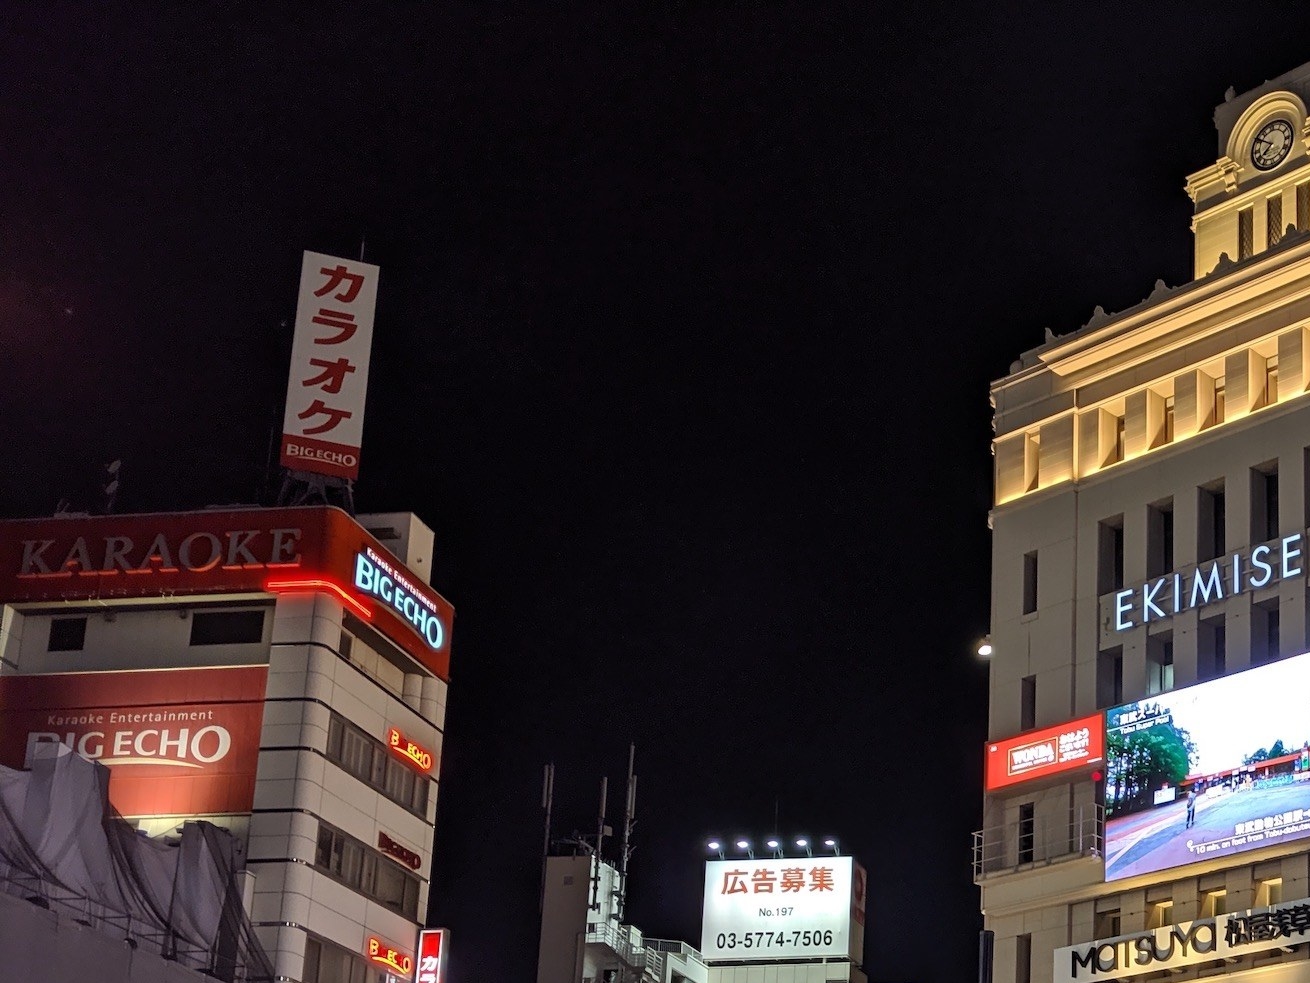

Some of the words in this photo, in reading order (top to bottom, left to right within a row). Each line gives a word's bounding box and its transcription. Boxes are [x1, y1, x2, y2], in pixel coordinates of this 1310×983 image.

[297, 265, 365, 435] カラオケ
[286, 443, 314, 458] BIG
[316, 450, 357, 467] ECHO
[17, 528, 302, 578] KARAOKE
[366, 547, 392, 575] Karaoke
[394, 570, 437, 613] Entertainment
[1115, 533, 1302, 631] EKIMISE
[355, 553, 392, 602] BIG
[395, 587, 443, 648] ECHO
[47, 714, 103, 725] Karaoke
[110, 710, 213, 724] Entertainment
[113, 725, 231, 763] ECHO
[1196, 846, 1205, 854] 10
[721, 866, 835, 895] 広告募集
[758, 907, 794, 917] No.197
[716, 929, 833, 949] 03-5774-7506
